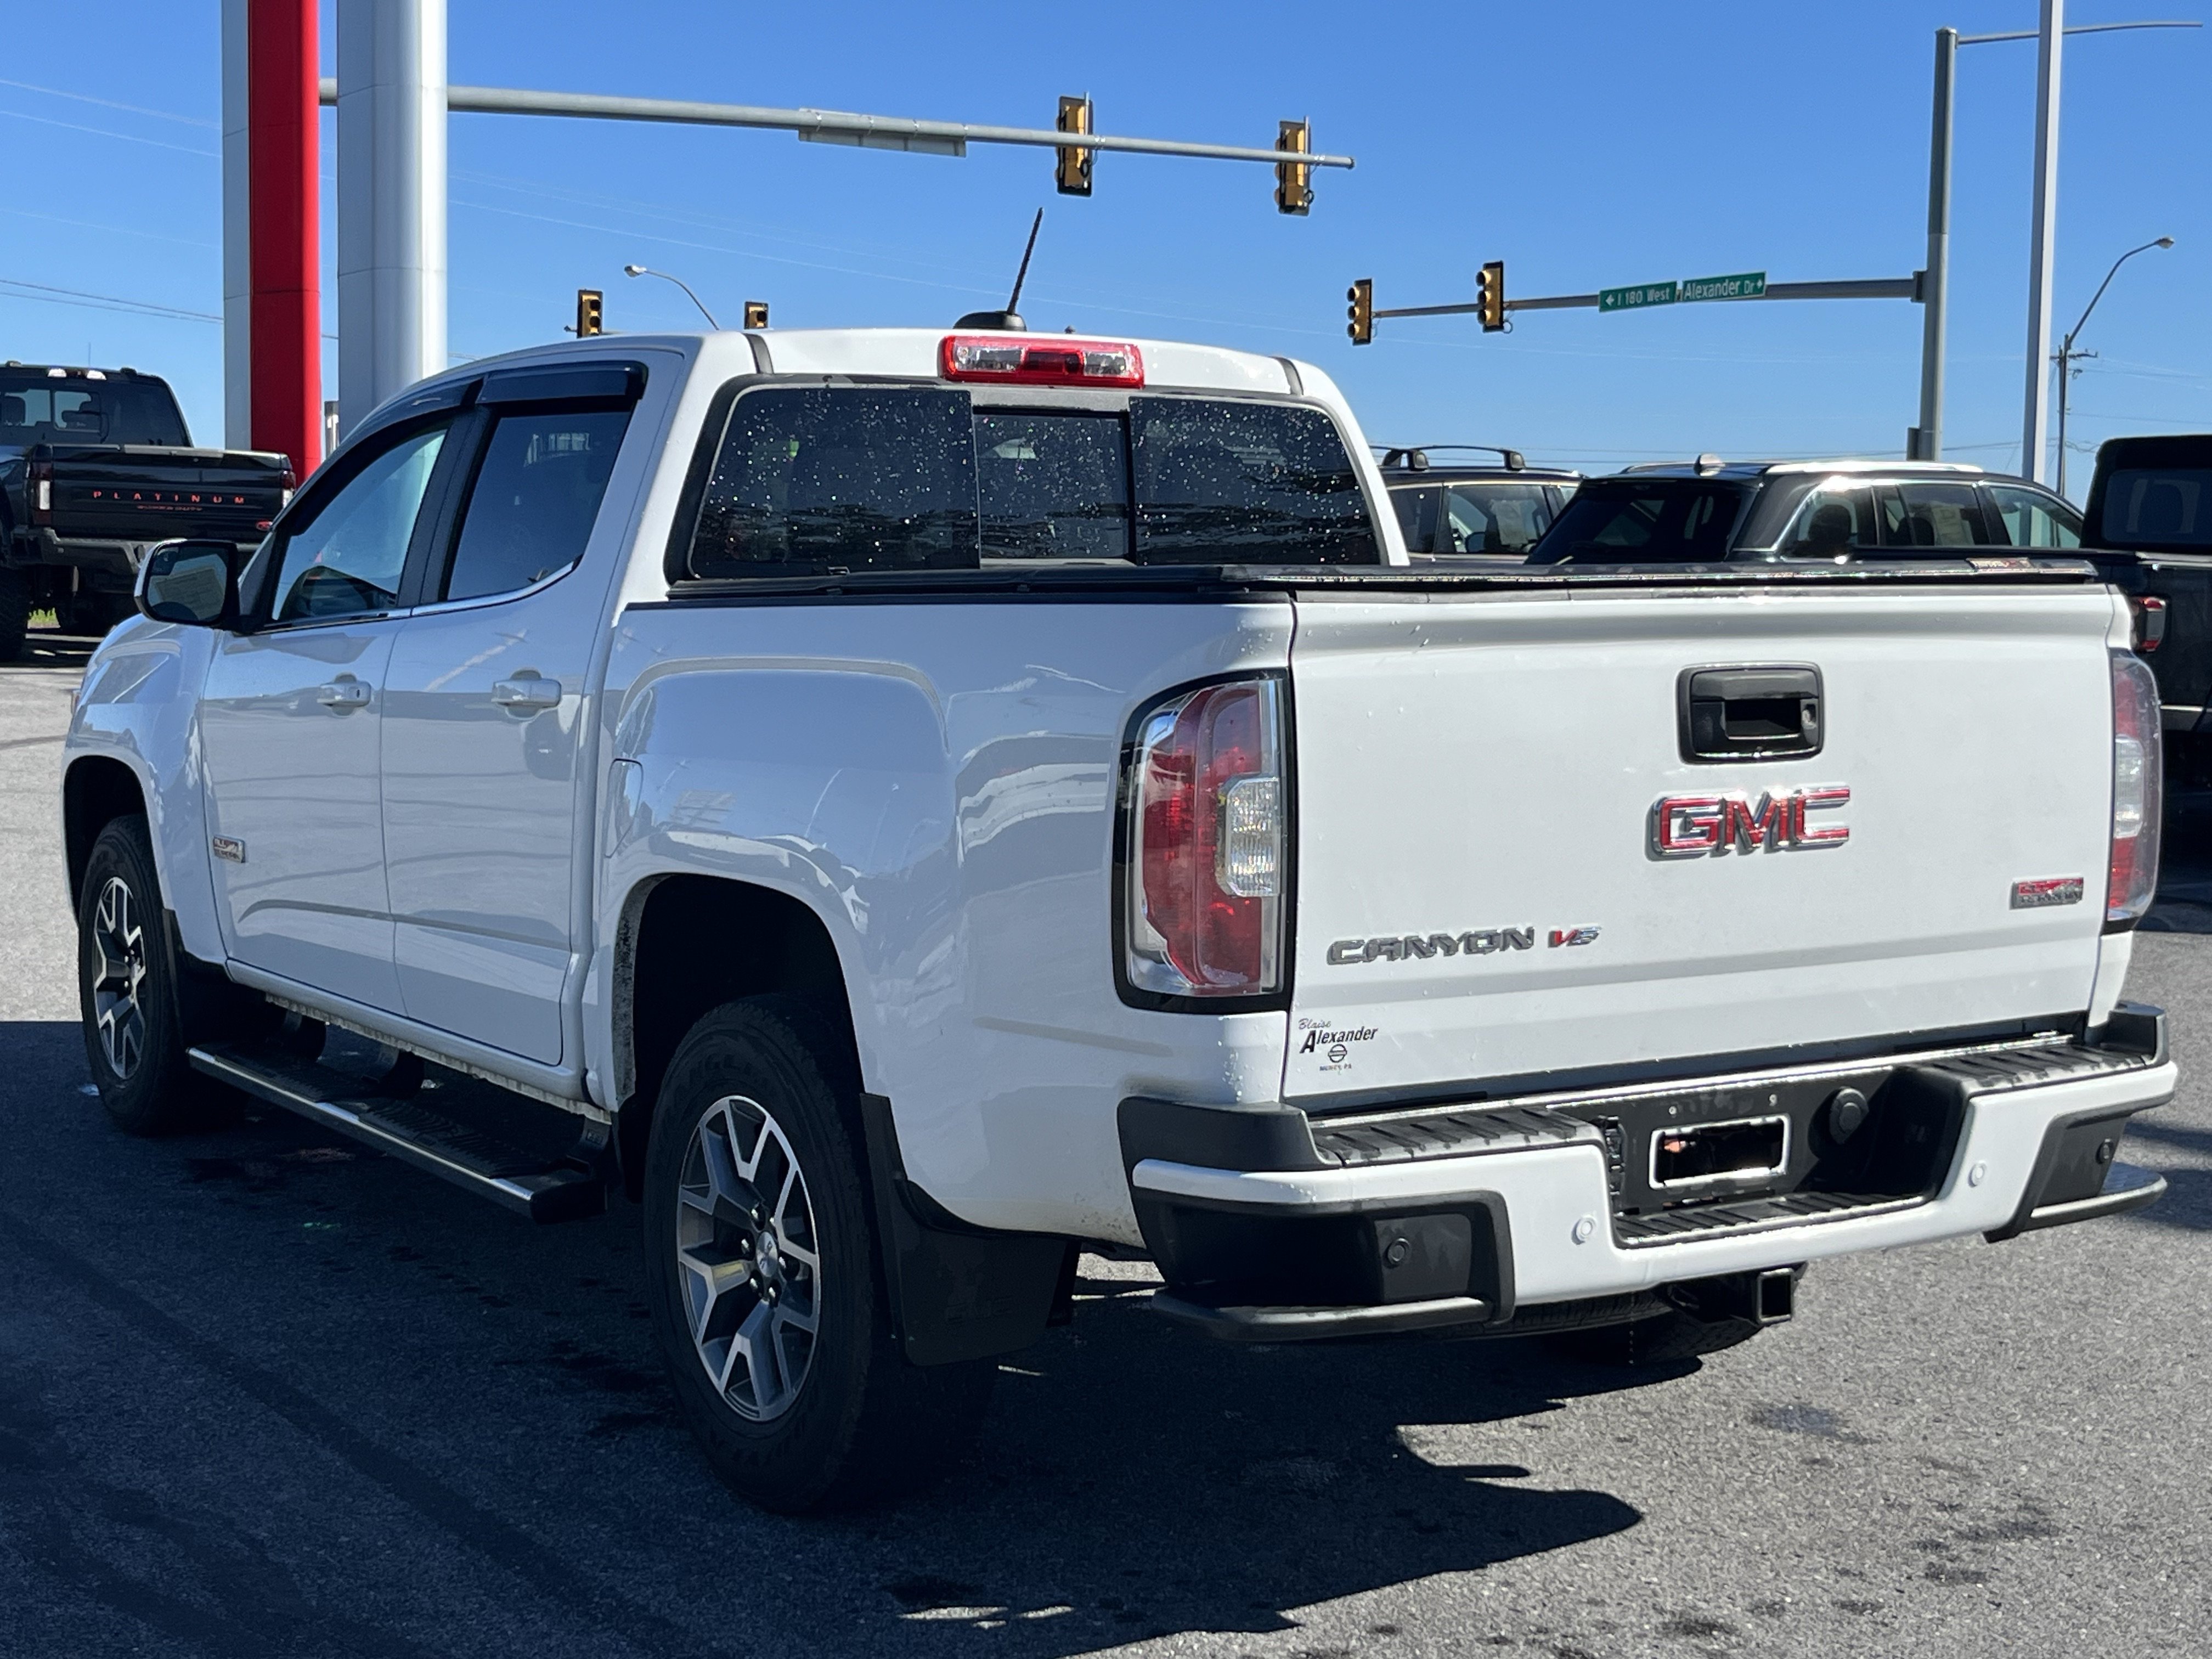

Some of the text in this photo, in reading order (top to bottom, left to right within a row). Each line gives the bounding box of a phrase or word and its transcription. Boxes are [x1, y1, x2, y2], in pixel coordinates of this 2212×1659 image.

[1617, 287, 1670, 306] I 180 West
[1684, 279, 1755, 300] Alexander Dr
[93, 491, 245, 504] PLATINUM
[1645, 782, 1850, 861] GMC
[1327, 925, 1602, 965] CANYON V6
[1298, 1018, 1331, 1030] Blaise
[1299, 1026, 1379, 1054] Alexander
